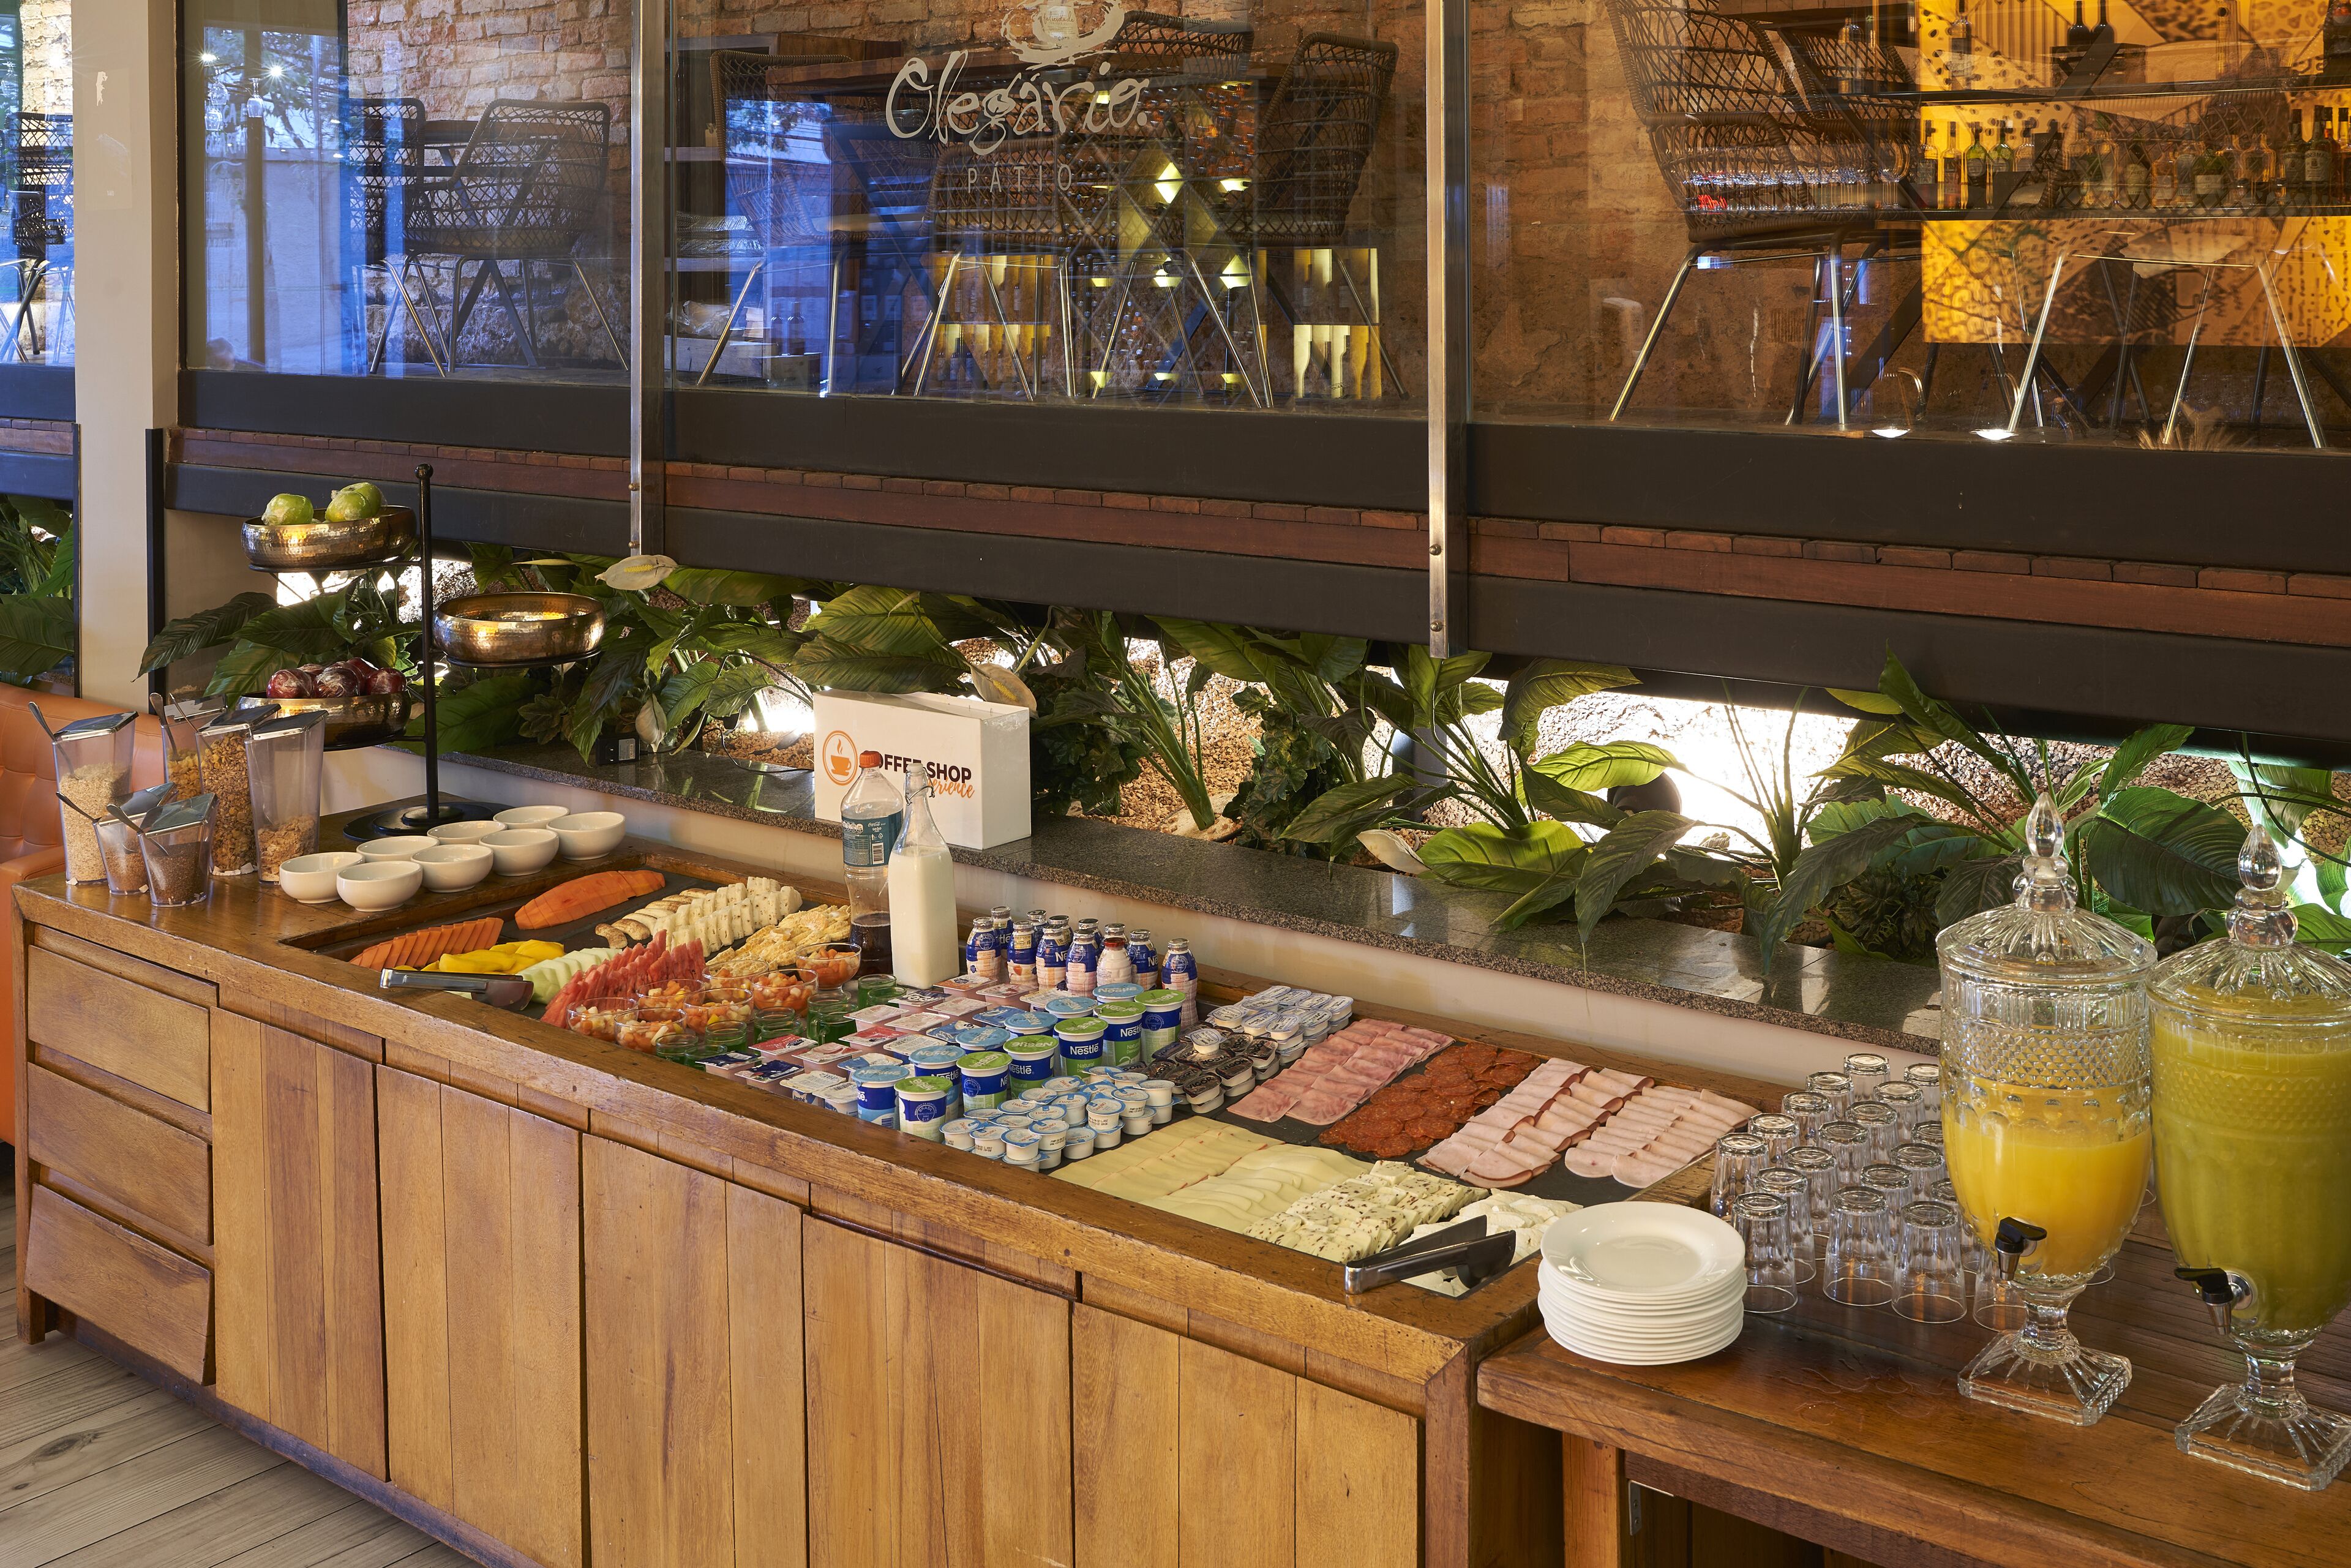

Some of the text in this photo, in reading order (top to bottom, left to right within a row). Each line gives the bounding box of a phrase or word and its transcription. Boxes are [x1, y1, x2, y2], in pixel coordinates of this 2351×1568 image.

[1043, 10, 1074, 24] felicidade
[968, 162, 1072, 193] PÁTIO
[876, 752, 972, 784] FFE SHOP
[927, 776, 975, 799] erience
[1070, 1043, 1099, 1055] Nestlé
[931, 1070, 959, 1082] estlé
[1187, 1076, 1214, 1089] VIGOR
